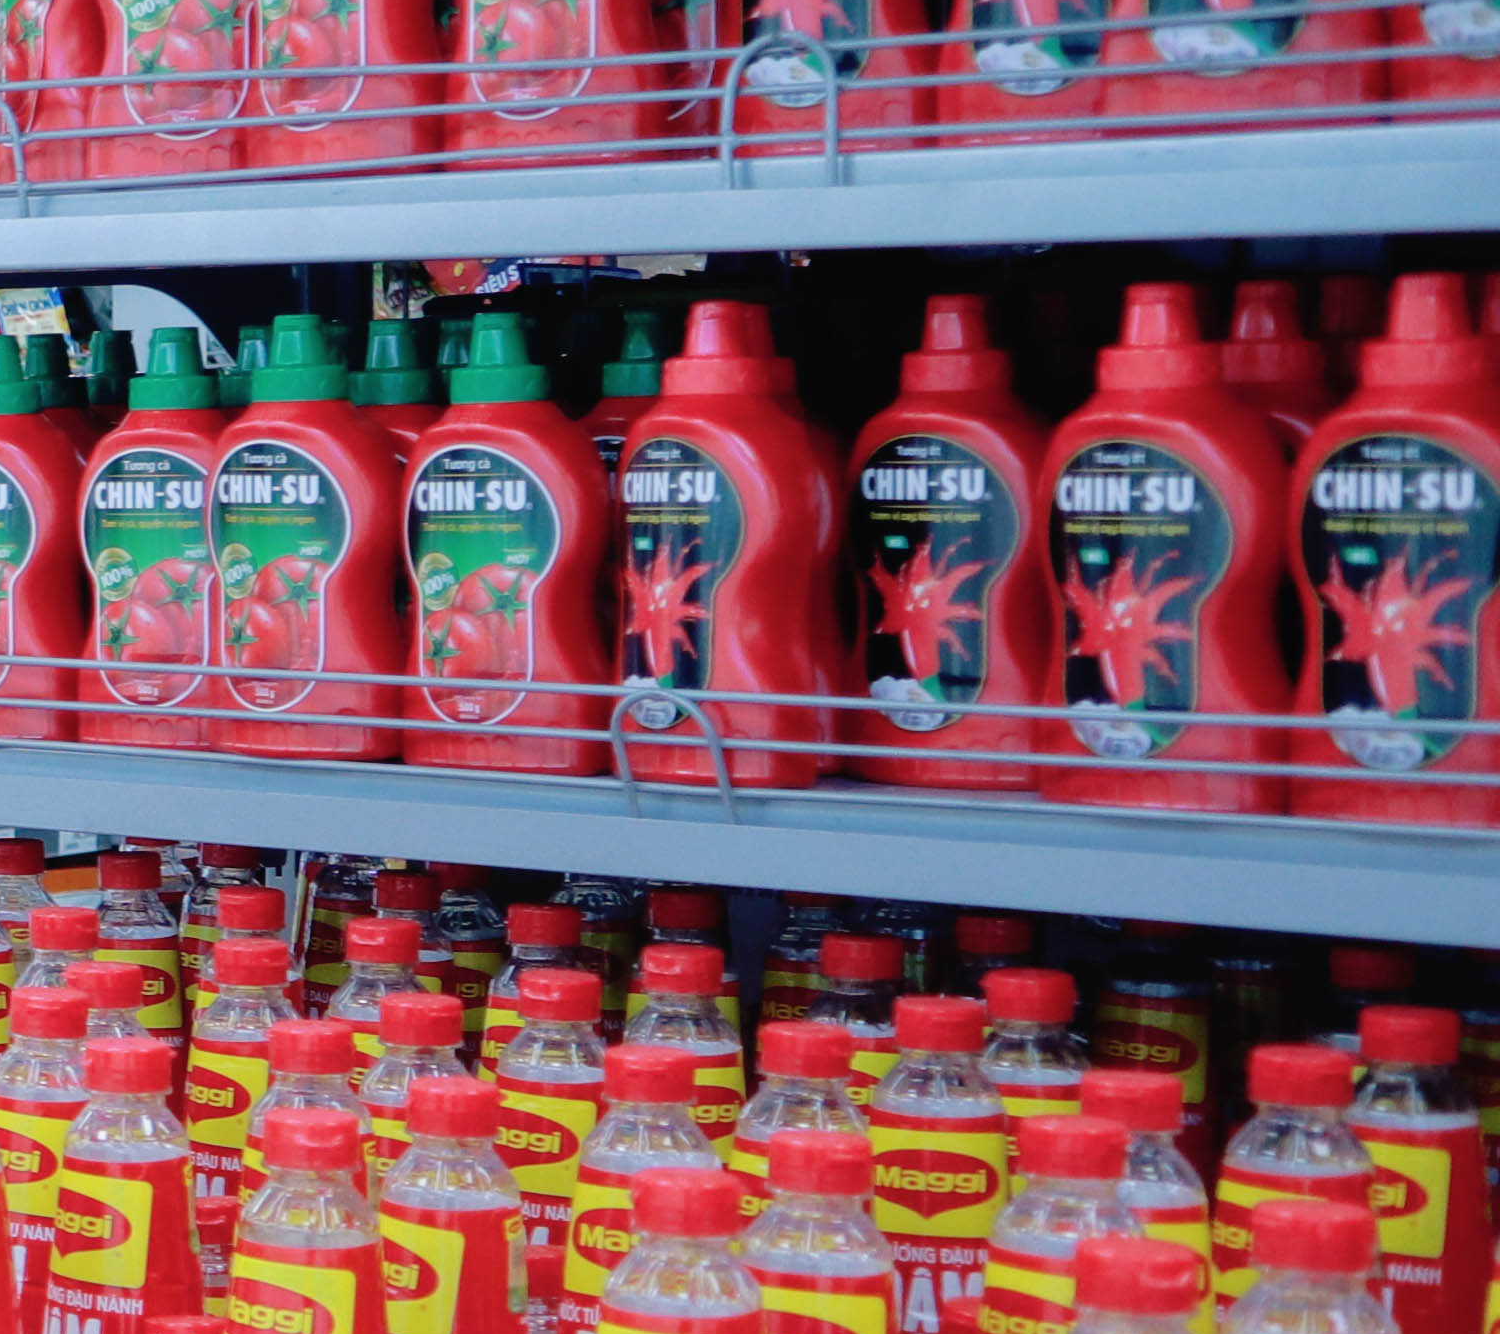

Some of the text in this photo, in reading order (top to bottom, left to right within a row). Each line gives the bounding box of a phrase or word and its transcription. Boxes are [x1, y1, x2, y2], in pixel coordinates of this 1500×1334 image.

[218, 474, 319, 506] CHIN-SU
[415, 479, 528, 513] CHIN-SU
[861, 466, 984, 504] CHIN-SU
[1056, 473, 1195, 515] CHIN-SU
[874, 1161, 988, 1197] Maggi
